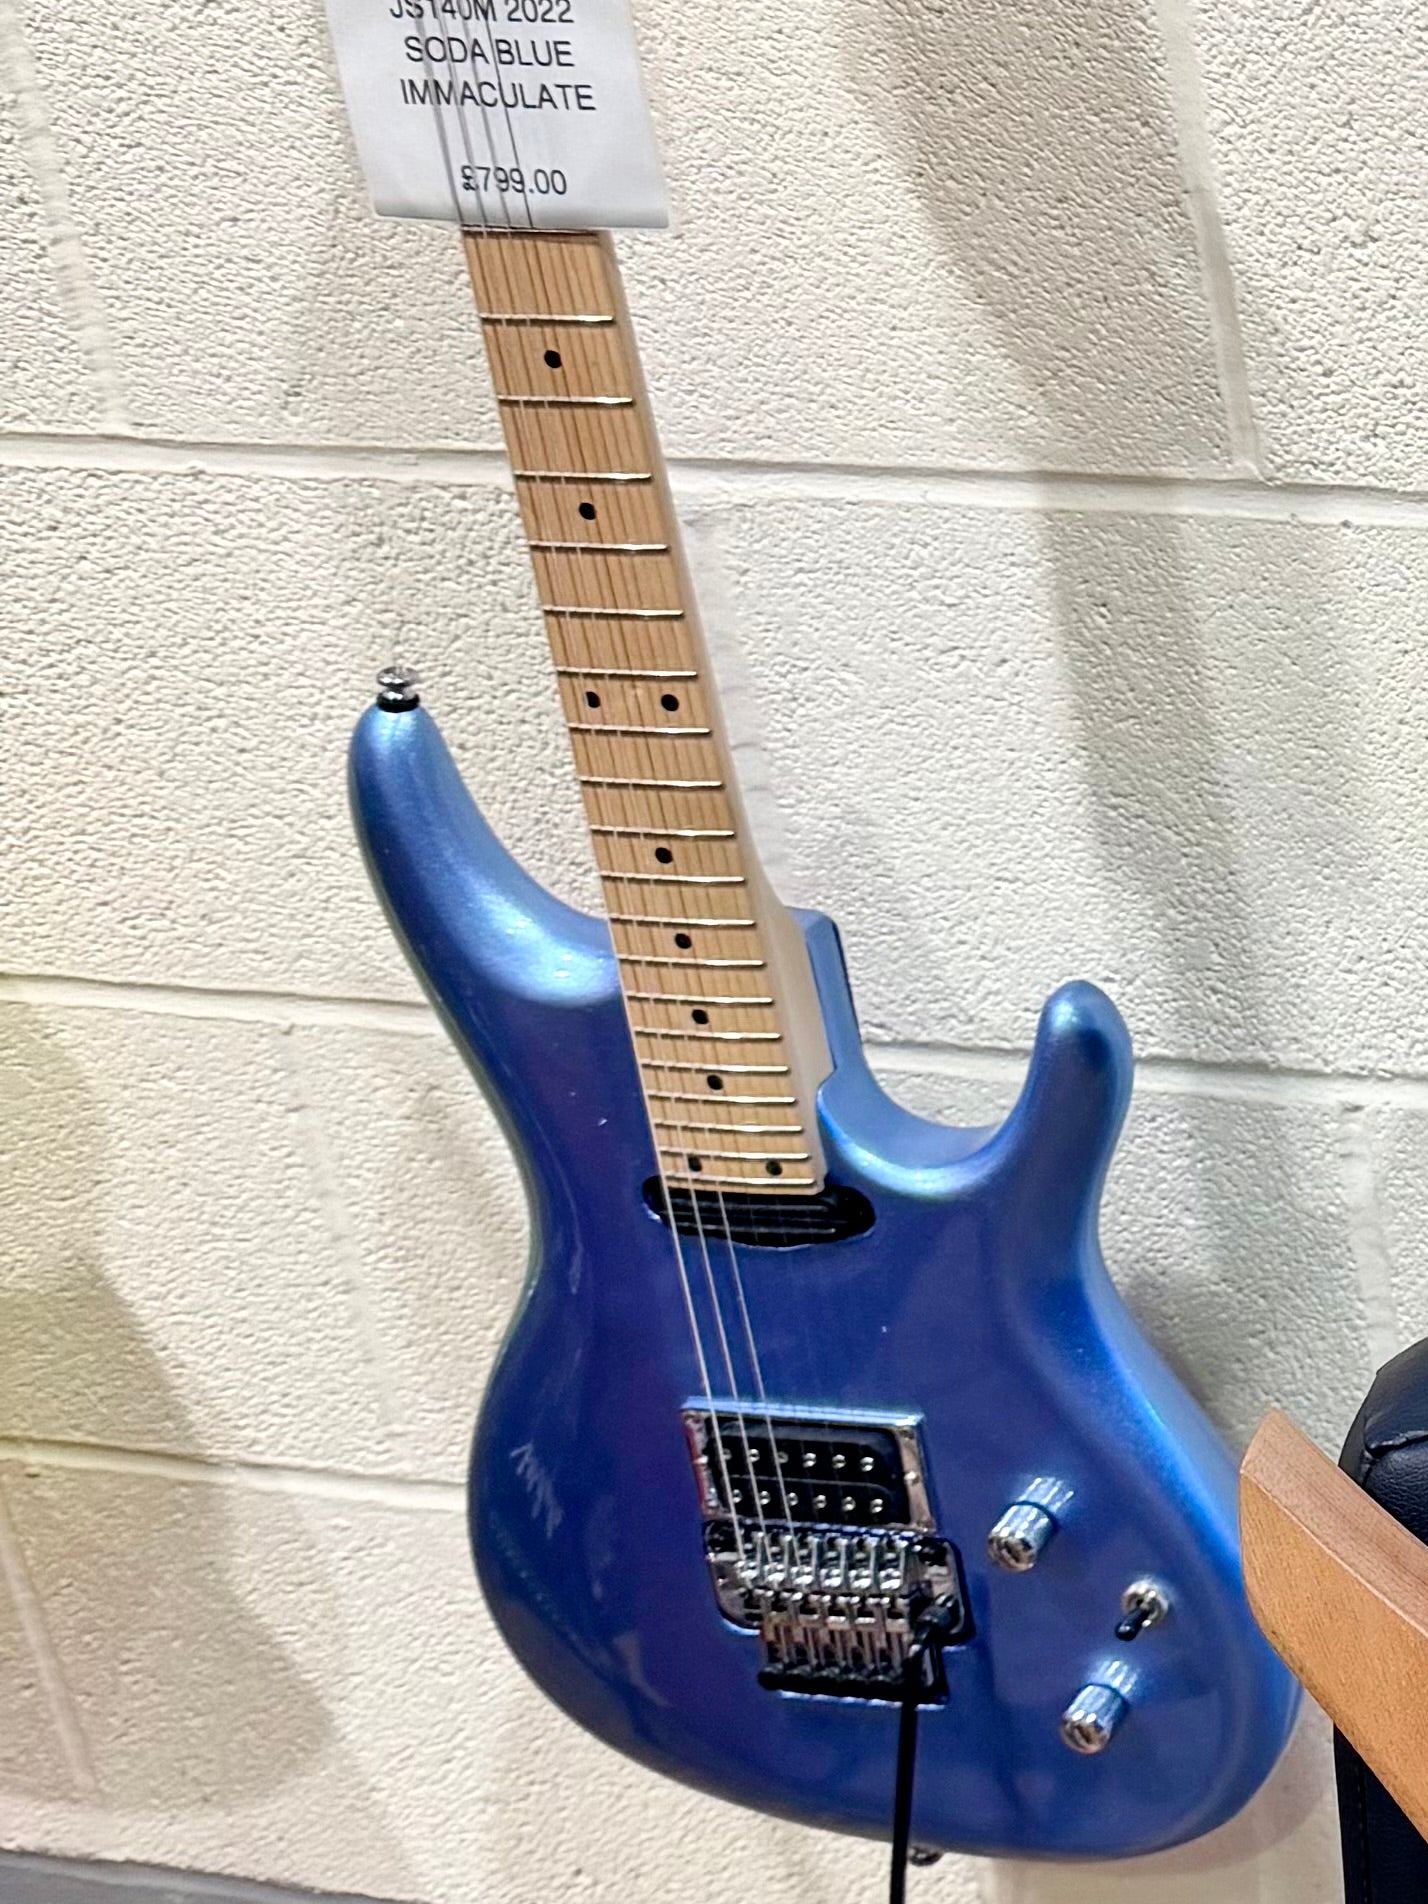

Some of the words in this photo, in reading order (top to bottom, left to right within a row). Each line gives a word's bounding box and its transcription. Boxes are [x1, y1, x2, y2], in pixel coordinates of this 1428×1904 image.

[404, 36, 490, 64] SODA
[494, 38, 575, 67] BLUE
[400, 79, 596, 110] IMMACULATE
[460, 165, 567, 195] £799.00
